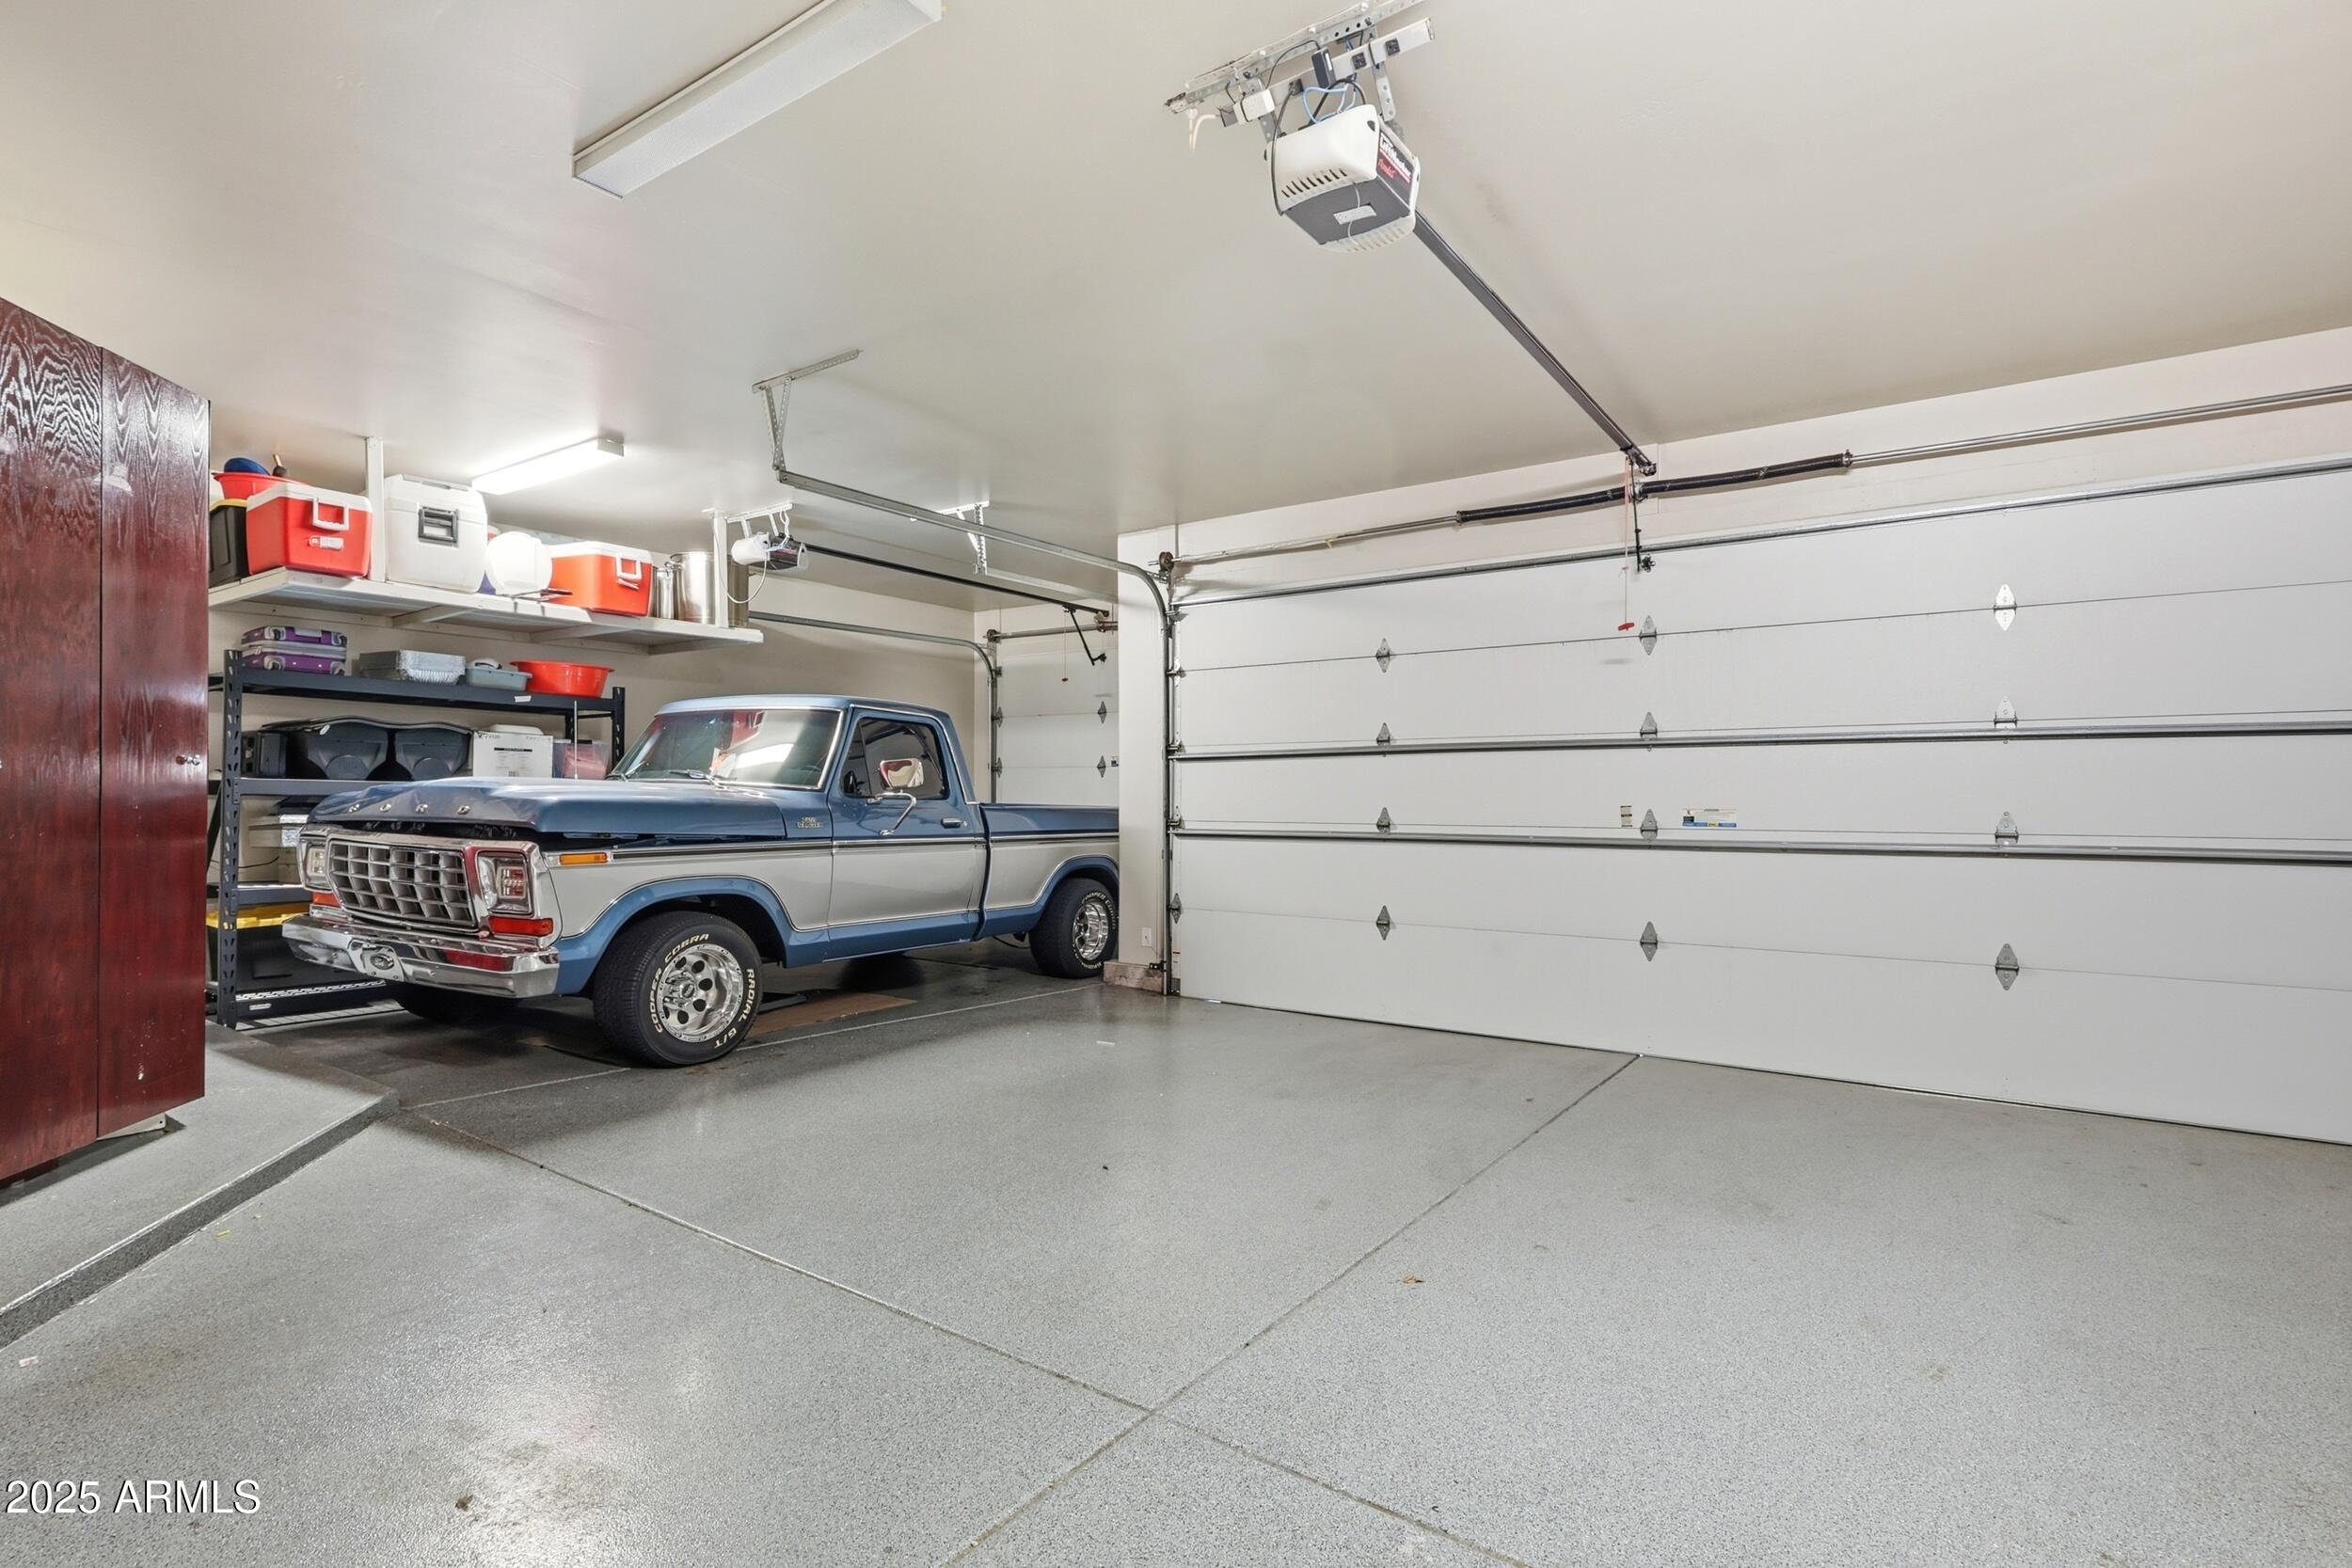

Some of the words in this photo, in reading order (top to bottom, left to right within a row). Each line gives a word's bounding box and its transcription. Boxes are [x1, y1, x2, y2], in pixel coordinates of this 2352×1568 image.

[649, 968, 663, 1033] COOPER
[664, 934, 709, 963] COBRA
[739, 969, 755, 1022] RADIAL
[714, 1027, 737, 1049] G/T
